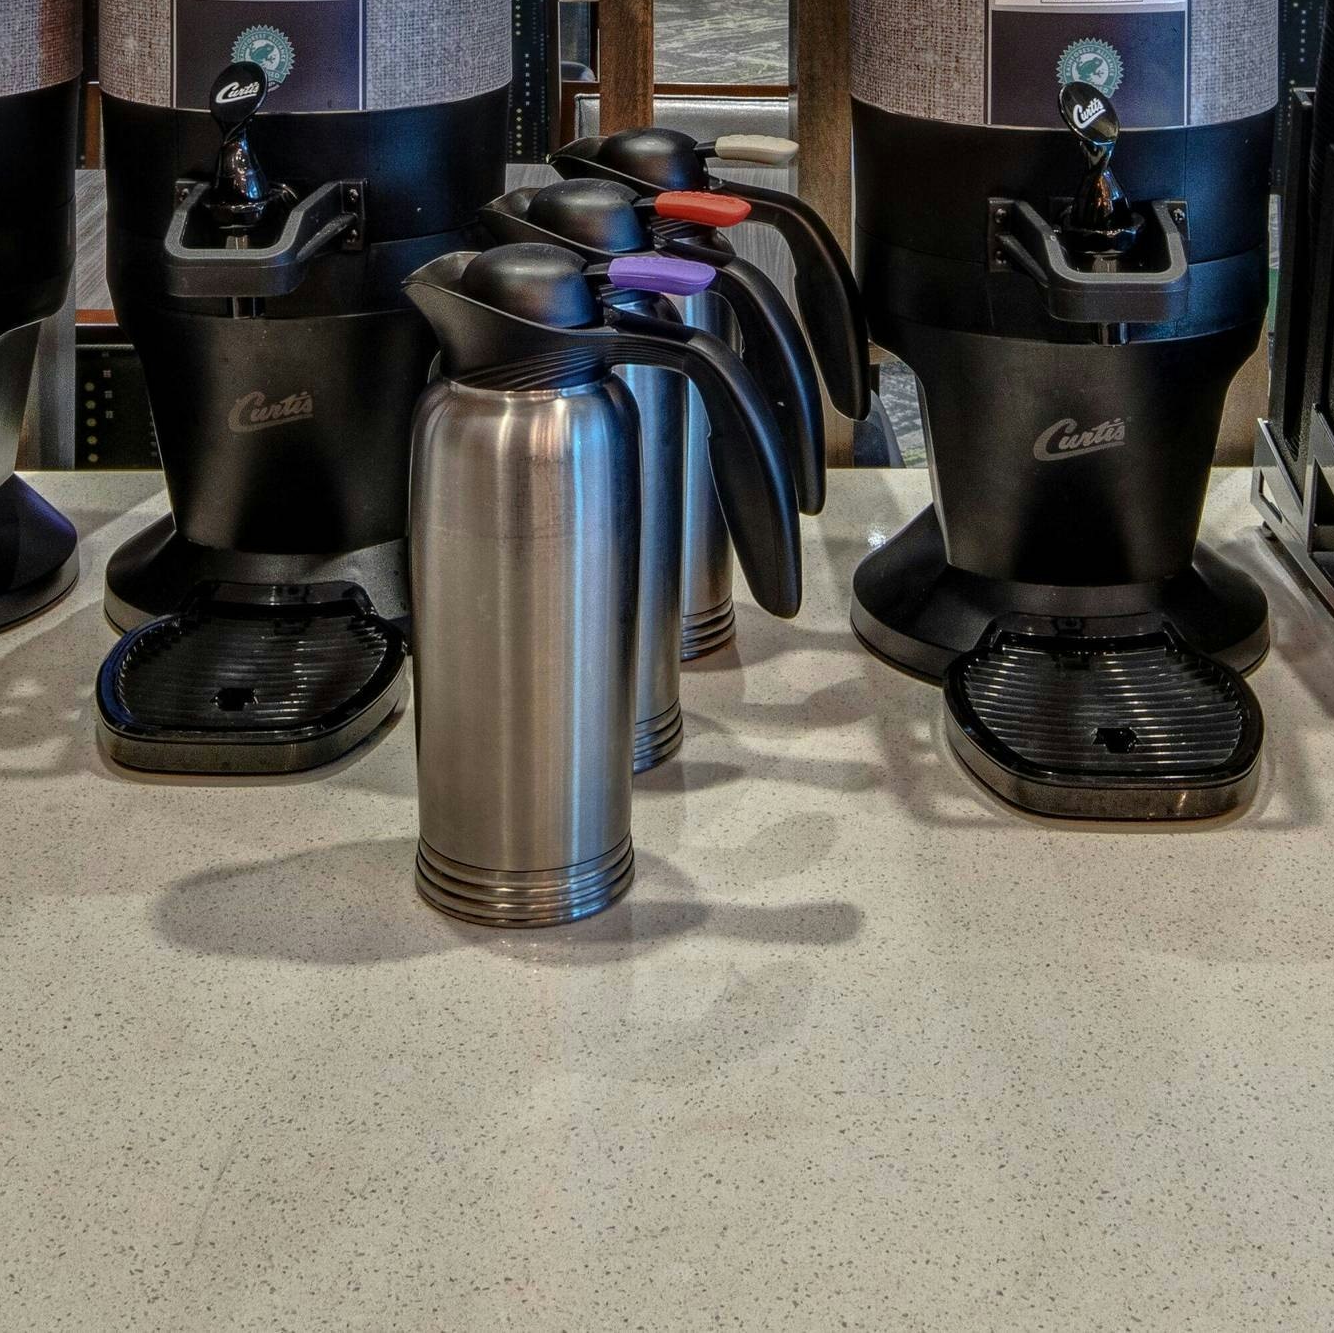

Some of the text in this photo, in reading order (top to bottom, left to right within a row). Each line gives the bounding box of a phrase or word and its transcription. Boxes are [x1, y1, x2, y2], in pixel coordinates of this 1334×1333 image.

[215, 81, 260, 104] Curtis
[1073, 97, 1106, 129] Curtis
[228, 391, 314, 433] Curtis
[1033, 417, 1126, 462] Curtis
